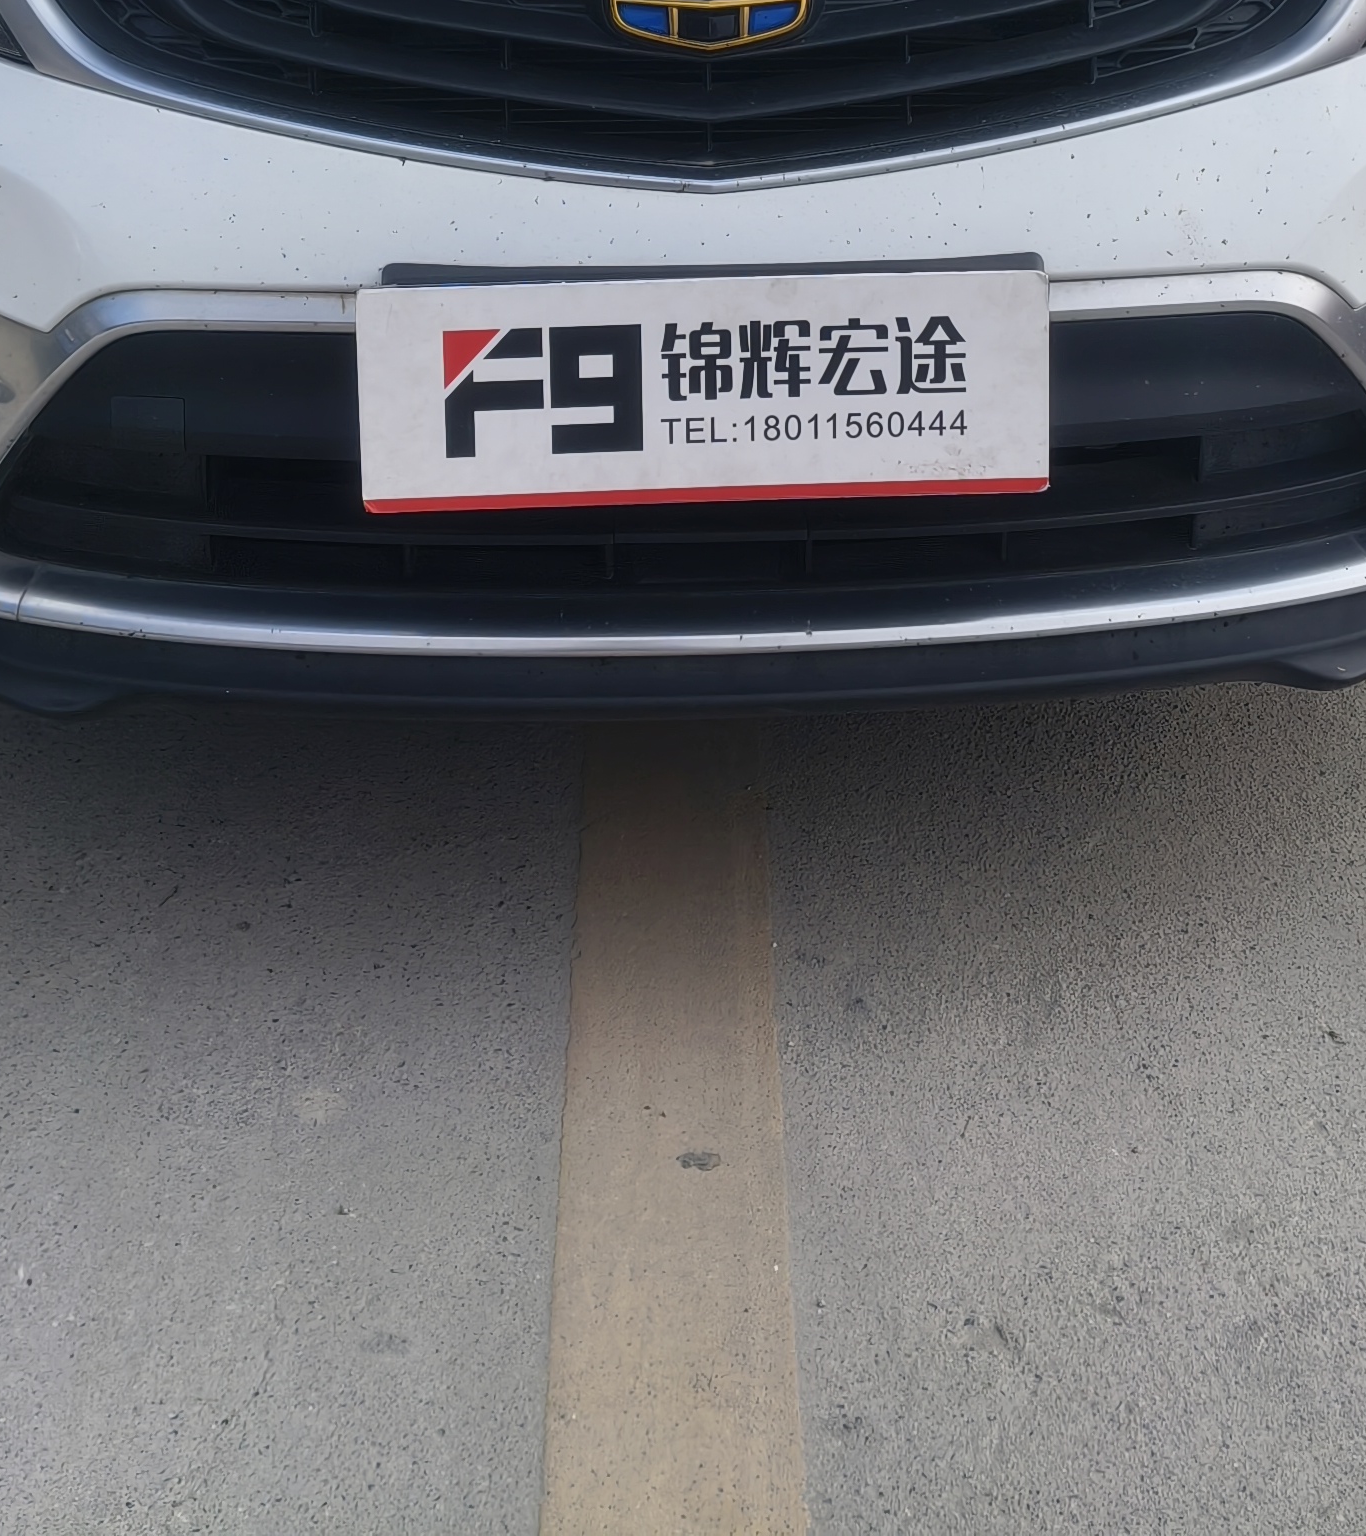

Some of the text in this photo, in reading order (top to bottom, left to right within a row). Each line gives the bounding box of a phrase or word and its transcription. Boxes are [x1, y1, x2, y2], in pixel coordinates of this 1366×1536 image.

[661, 315, 967, 402] 锦辉宏途
[661, 409, 968, 445] TEL:18011560444
